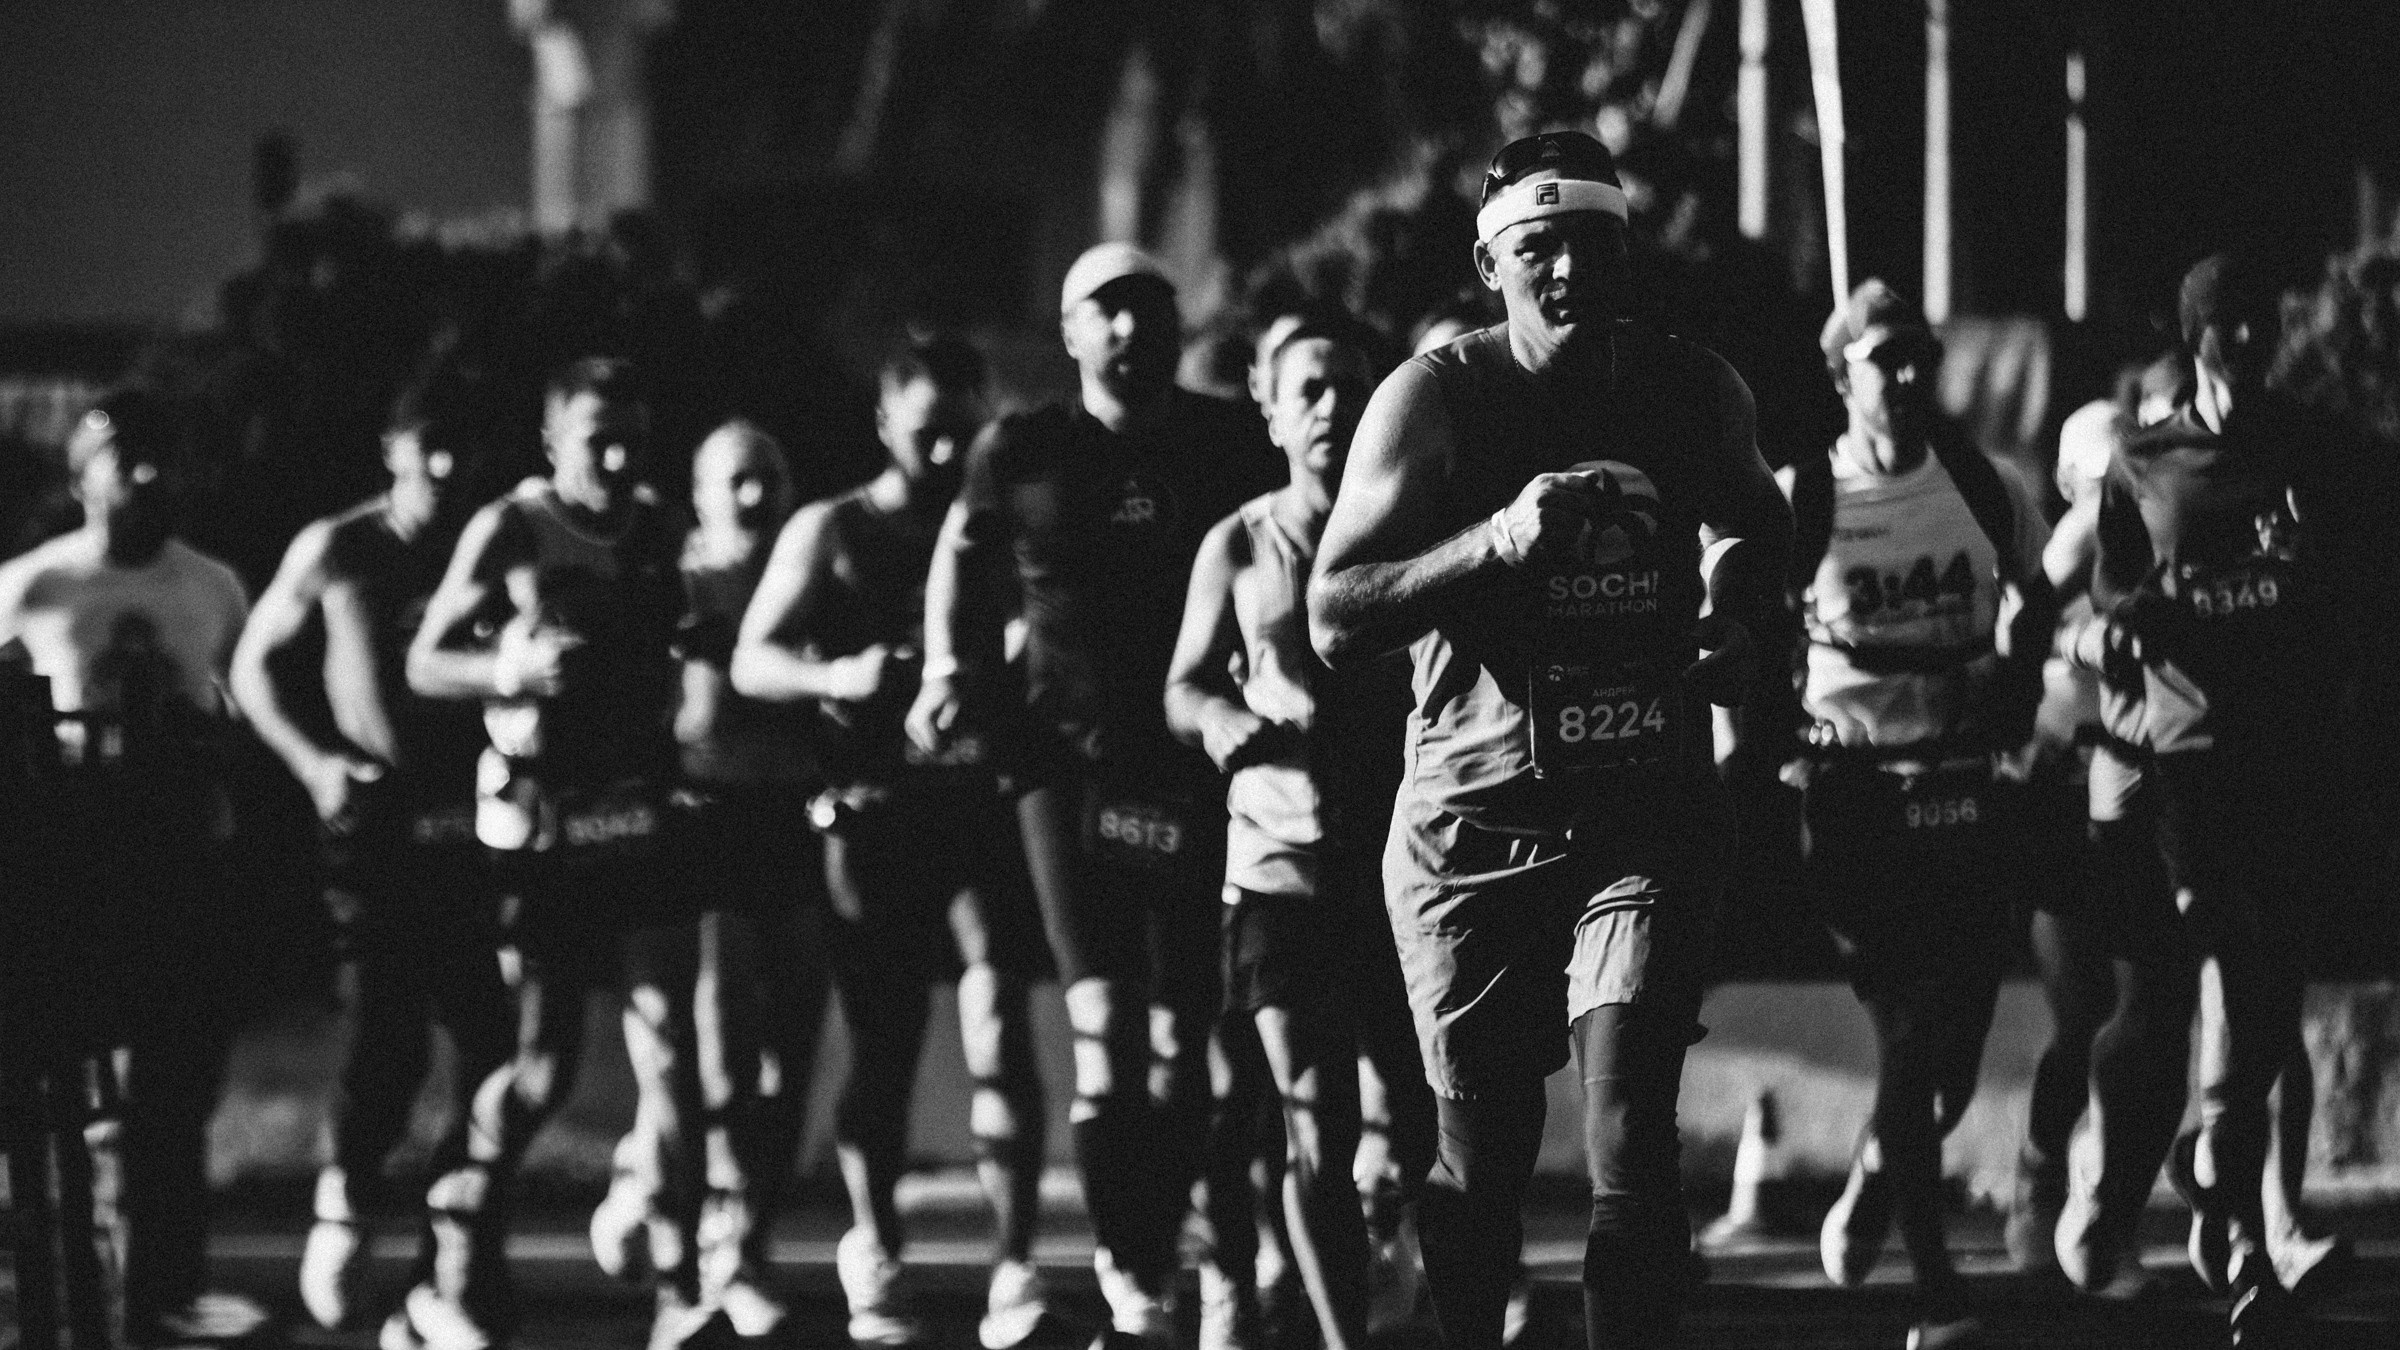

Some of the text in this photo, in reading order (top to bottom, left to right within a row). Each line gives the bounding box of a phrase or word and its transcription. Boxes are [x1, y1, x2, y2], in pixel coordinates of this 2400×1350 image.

[1548, 570, 1659, 600] SOCHI
[1844, 549, 1976, 614] 3:44
[1547, 599, 1657, 618] MARATHON
[1559, 697, 1666, 743] 8224
[1100, 809, 1180, 853] 8613
[1905, 798, 1978, 829] 9056
